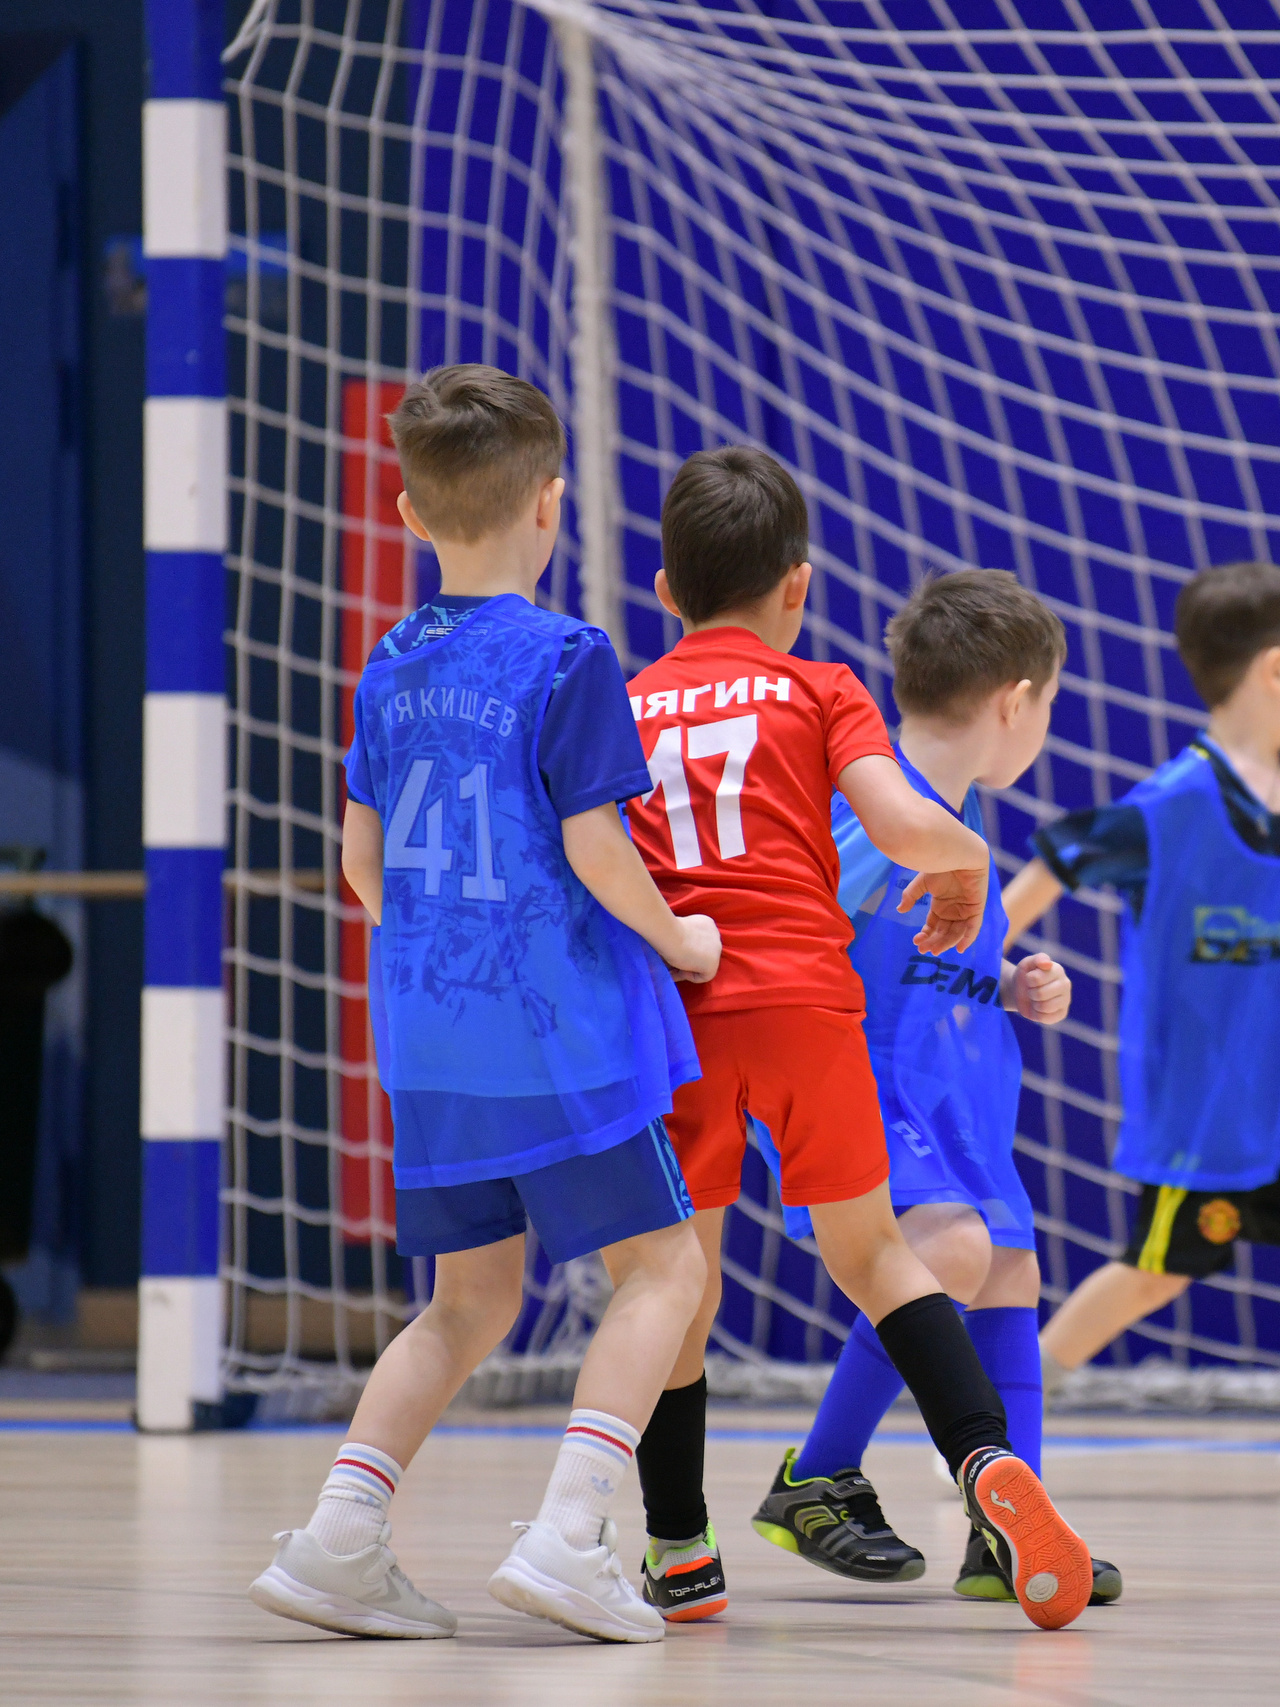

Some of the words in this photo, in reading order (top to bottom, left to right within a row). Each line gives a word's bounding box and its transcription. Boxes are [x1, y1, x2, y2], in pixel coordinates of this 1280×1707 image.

[385, 759, 507, 902] 41
[642, 714, 758, 870] 17
[900, 955, 1003, 1008] DEM
[668, 1574, 722, 1597] TOP-FLEX
